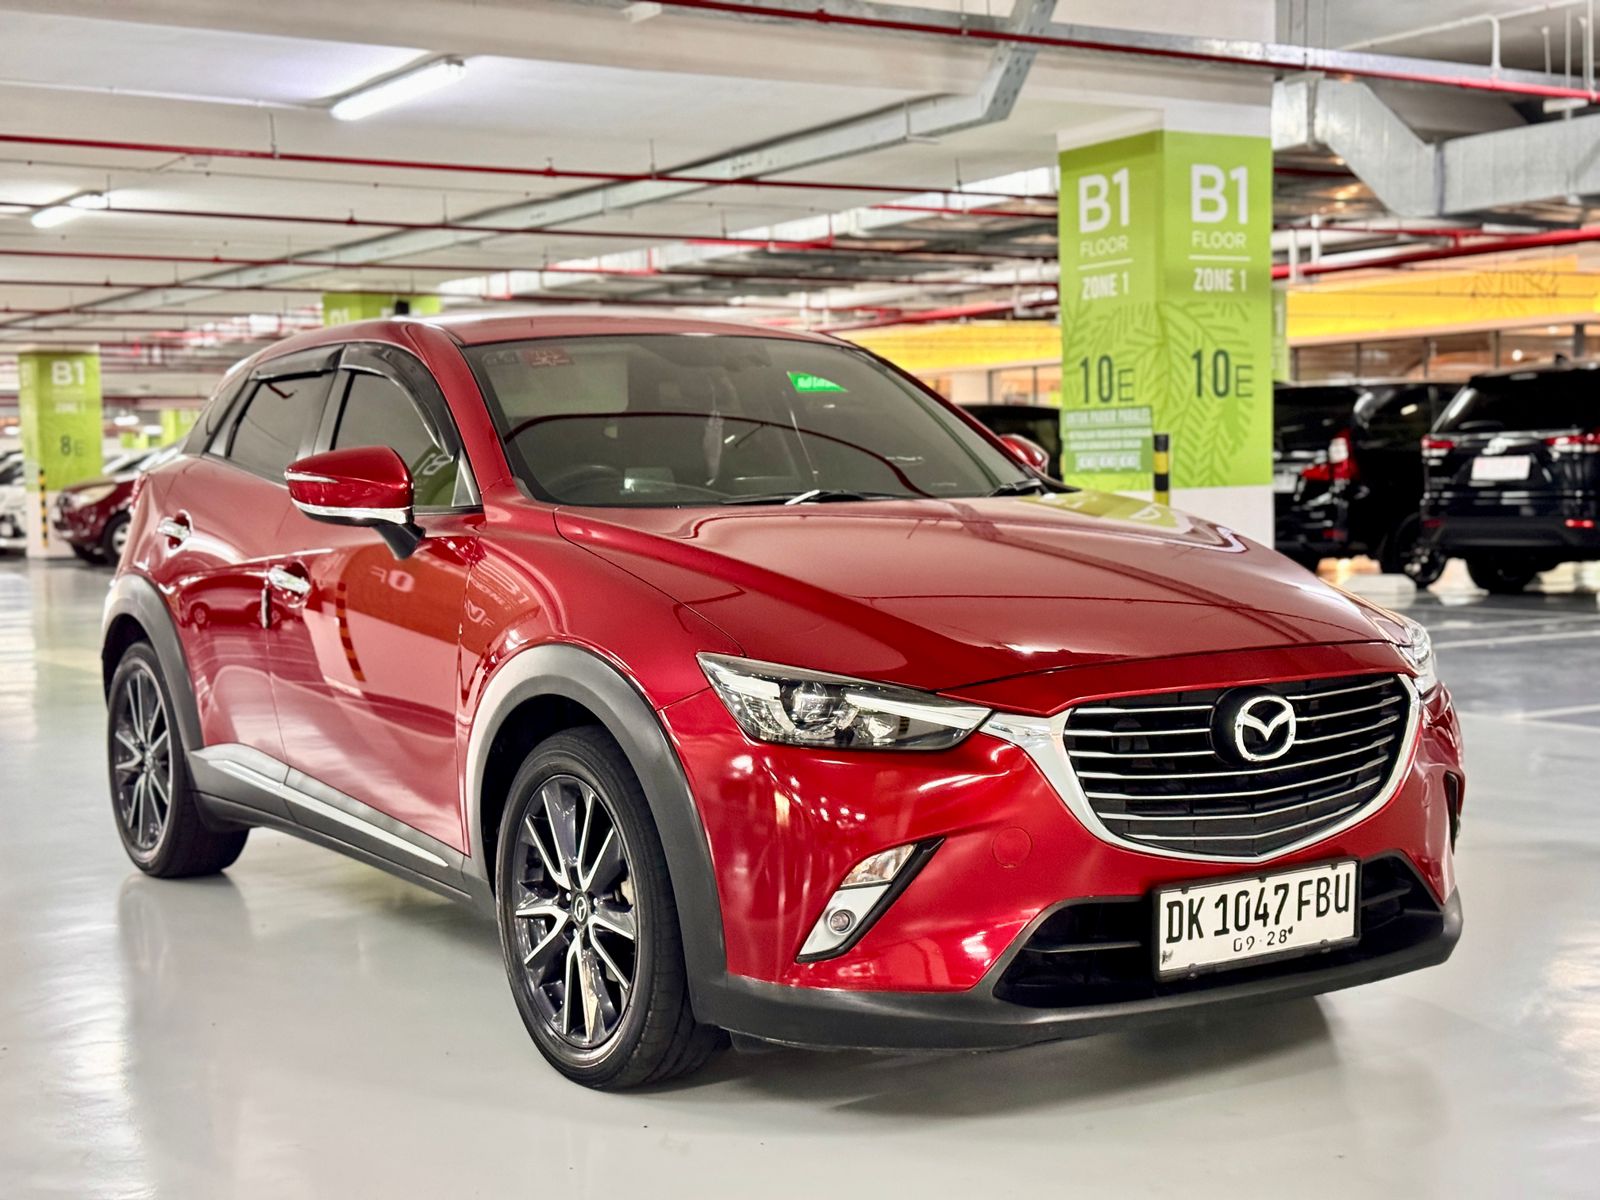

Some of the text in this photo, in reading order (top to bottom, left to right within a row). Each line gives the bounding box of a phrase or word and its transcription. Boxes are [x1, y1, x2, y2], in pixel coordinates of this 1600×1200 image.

[1078, 167, 1130, 234] B1
[1190, 163, 1249, 225] B1
[1080, 235, 1129, 257] FLOOR
[1192, 230, 1247, 249] FLOOR
[1081, 271, 1130, 300] ZONE 1
[1193, 267, 1247, 292] ZONE 1
[52, 360, 86, 386] B1
[1166, 872, 1351, 944] DK 1047 FBU
